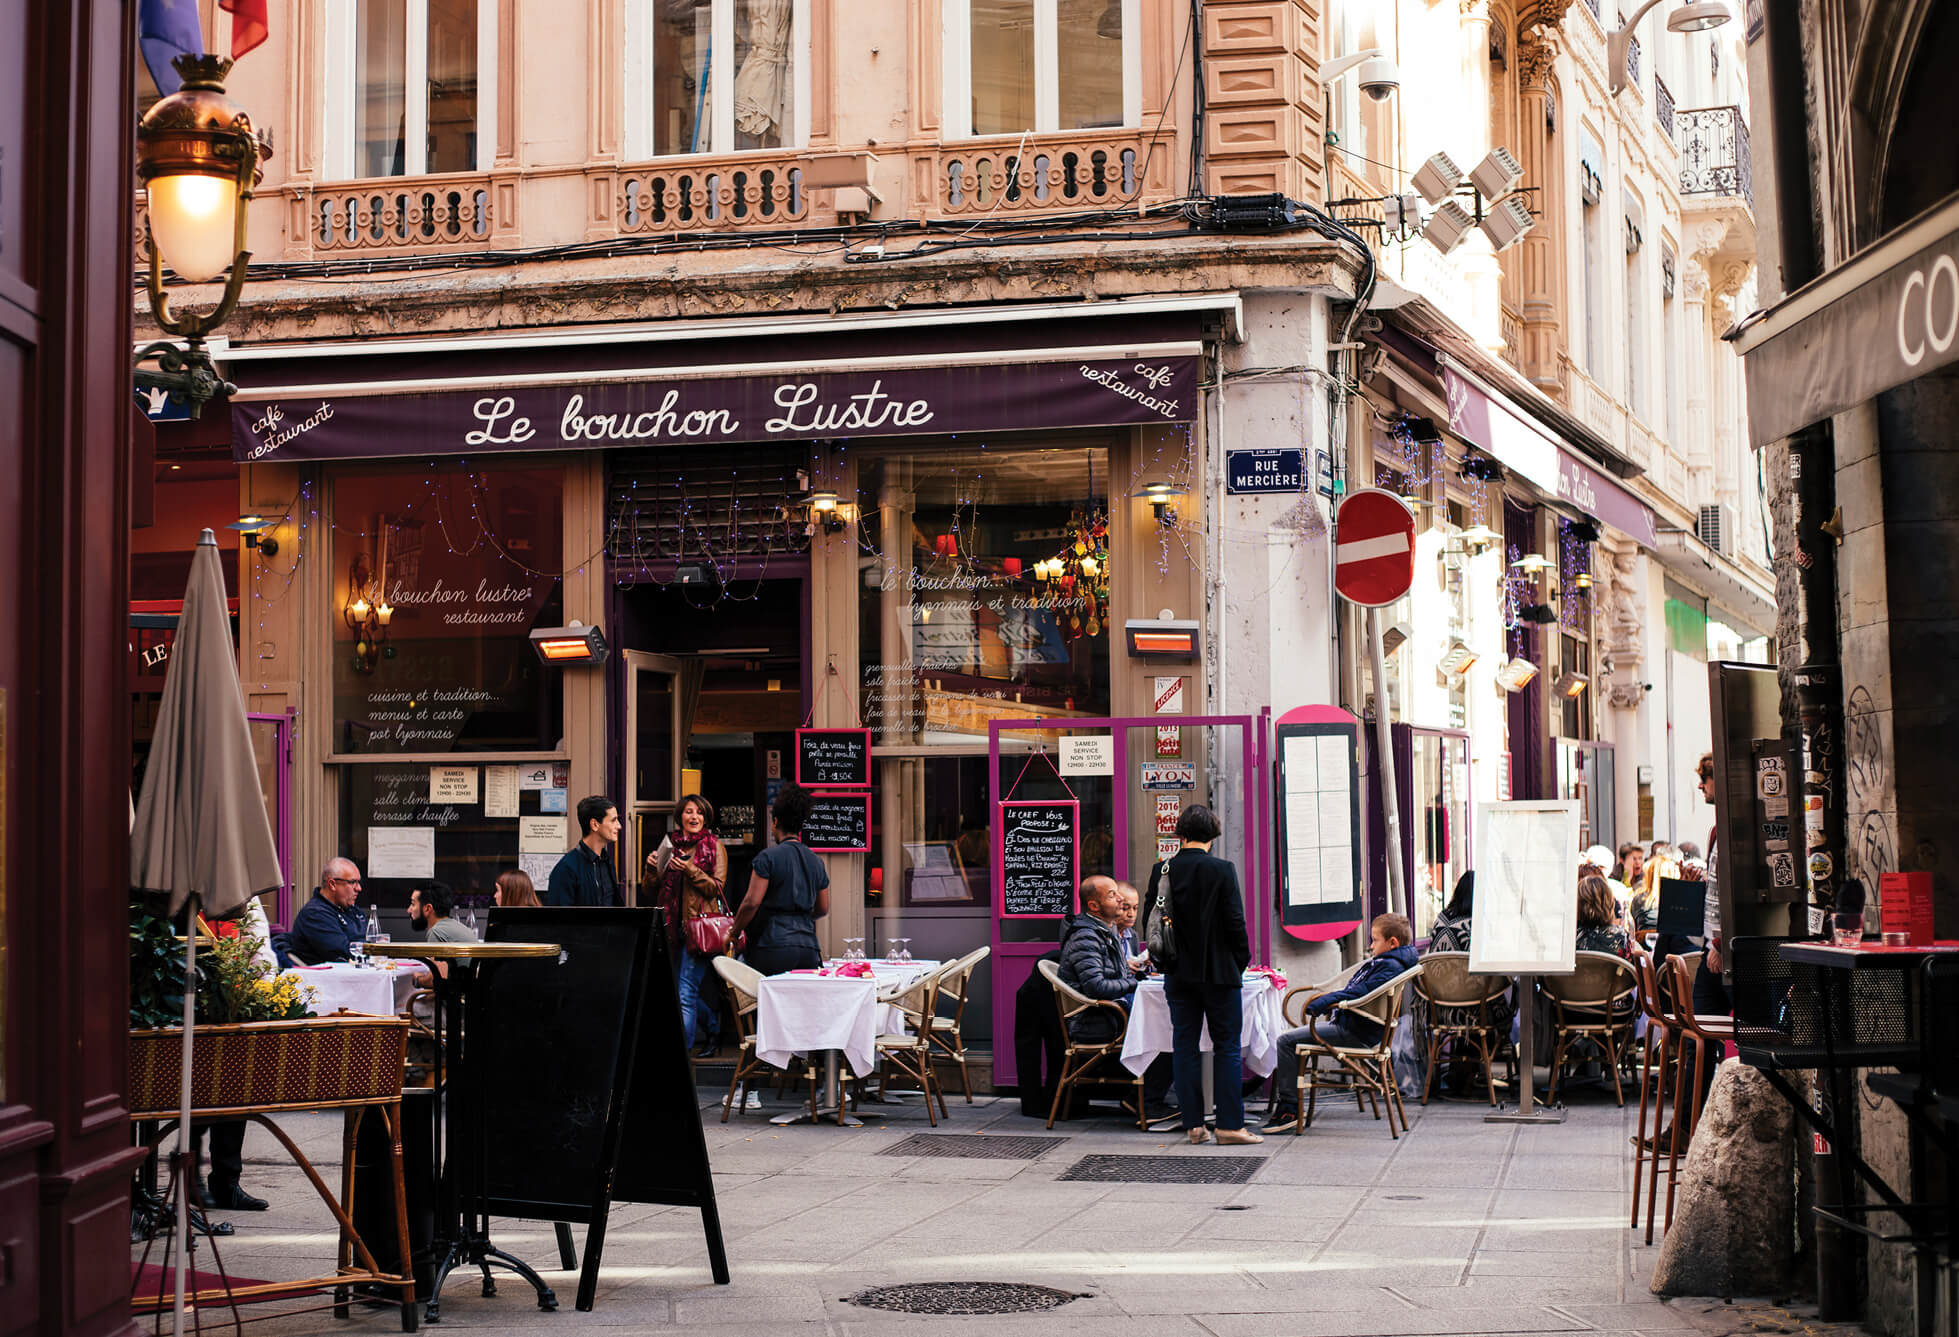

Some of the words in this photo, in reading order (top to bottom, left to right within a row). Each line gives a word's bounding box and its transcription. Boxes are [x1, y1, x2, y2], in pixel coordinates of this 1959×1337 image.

[1133, 362, 1174, 390] café
[1079, 363, 1180, 418] restaurant
[251, 403, 285, 435] café
[465, 396, 536, 445] Le
[560, 389, 740, 442] bouchon
[765, 379, 934, 433] Lustre
[247, 401, 335, 460] restaurant
[1255, 460, 1279, 472] RUE
[1236, 472, 1298, 487] MERCIÈRE
[880, 569, 897, 592] le
[367, 580, 383, 604] le
[390, 578, 468, 604] bouchon
[906, 597, 983, 620] lyonnais
[989, 594, 1004, 609] et
[1012, 592, 1087, 609] tradition
[443, 608, 525, 624] restaurant
[141, 643, 168, 667] LE
[367, 689, 412, 702] cuisine
[416, 689, 428, 701] et
[909, 690, 920, 700] de
[1157, 680, 1181, 708] LICENCE
[368, 710, 412, 721] menus
[416, 709, 428, 721] et
[432, 709, 464, 721] carte
[865, 708, 884, 723] foie
[368, 727, 391, 744] pot
[395, 724, 454, 746] lyonnais
[1145, 771, 1192, 781] LYON
[373, 791, 399, 805] salle
[1158, 802, 1179, 811] 2016
[373, 809, 414, 821] terrasse
[1046, 810, 1063, 819] VOUS
[1159, 823, 1177, 832] fut
[1159, 844, 1179, 852] 2017
